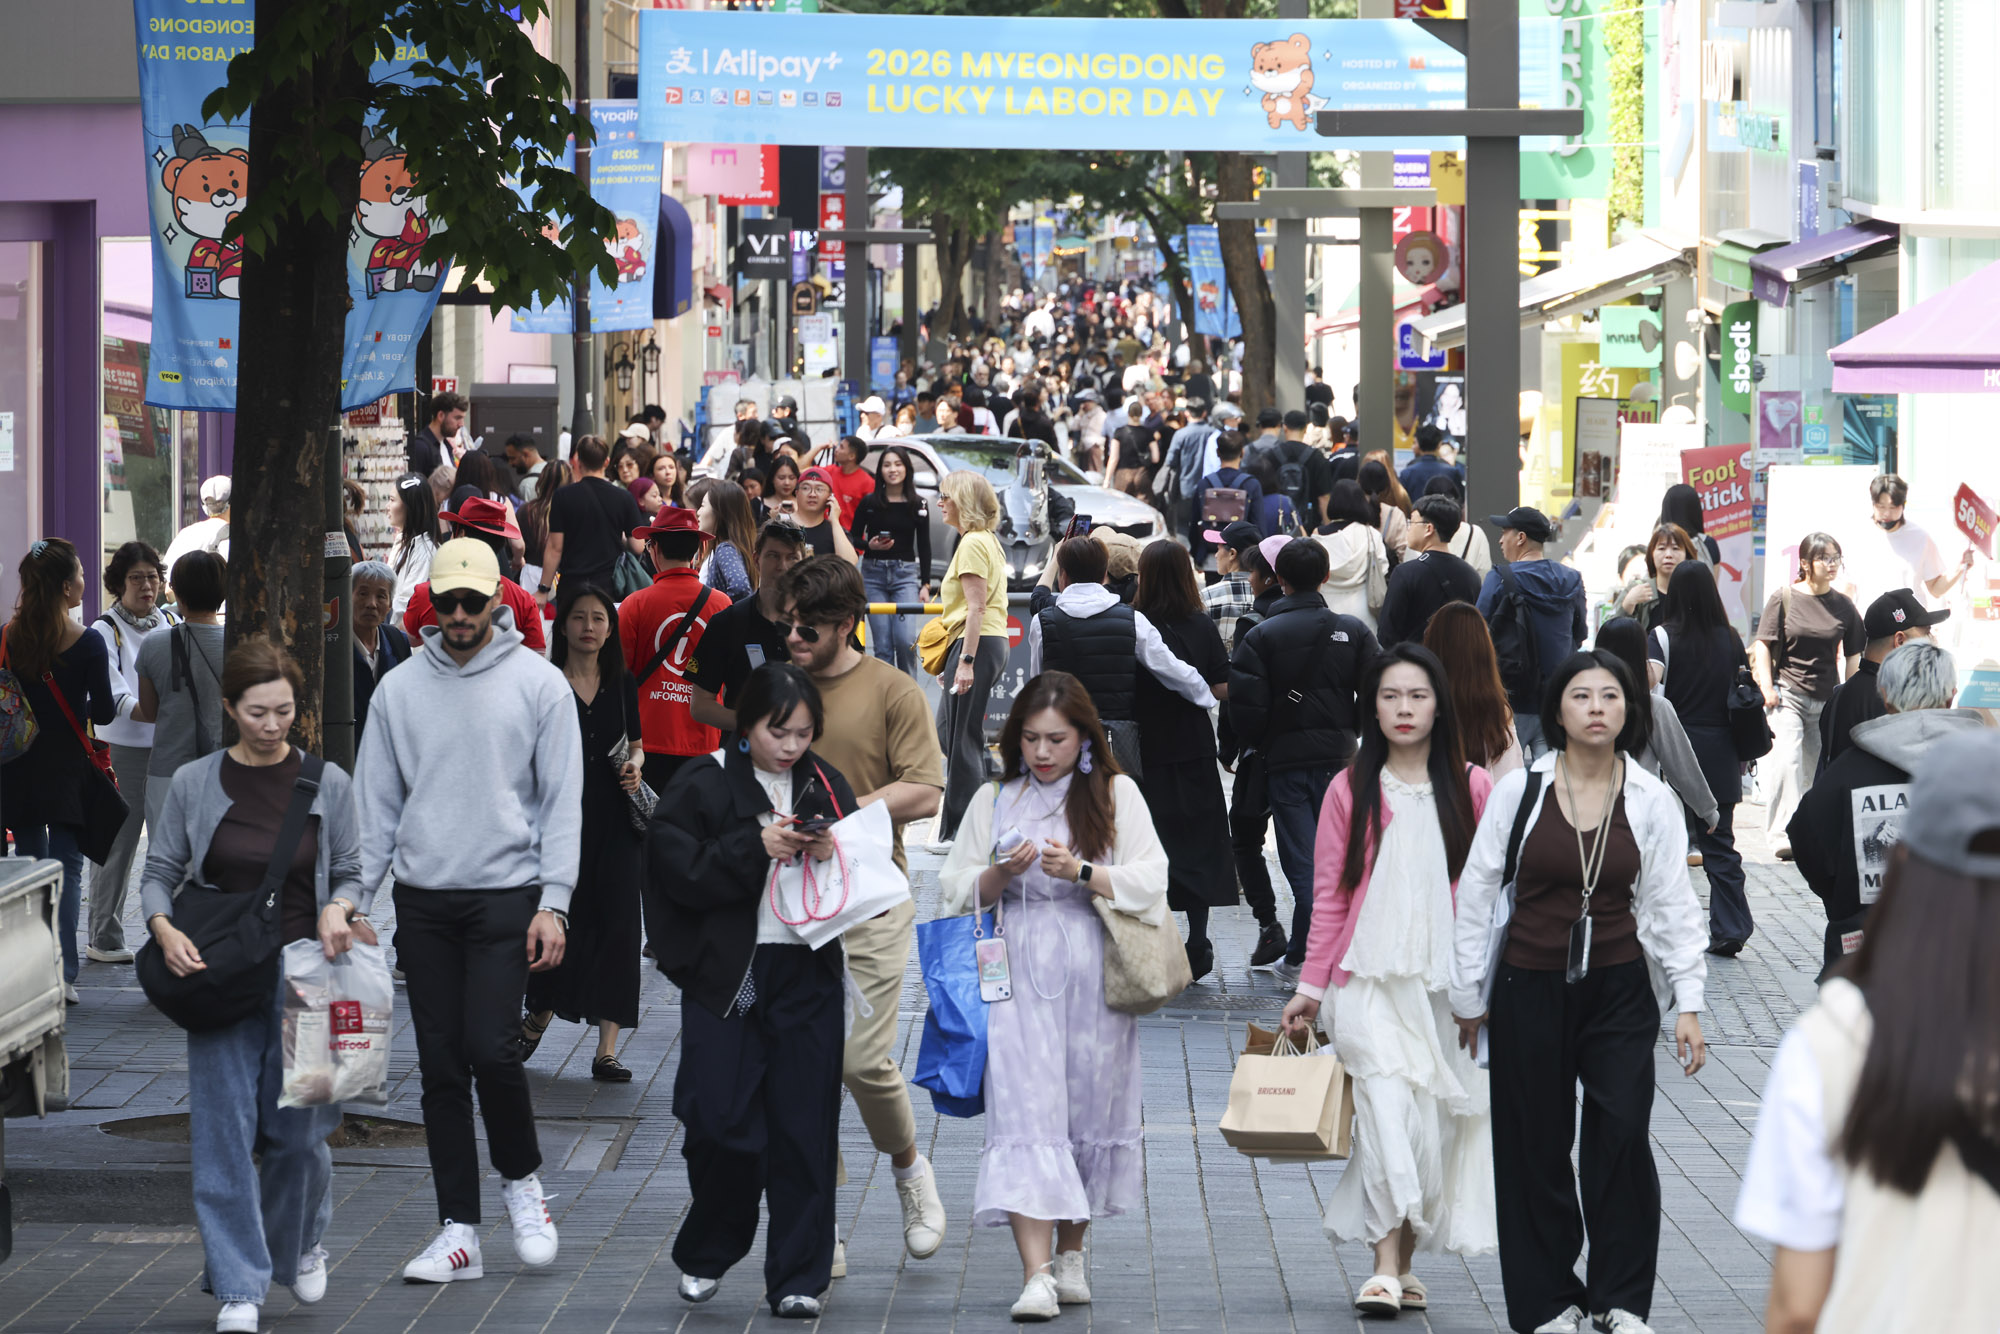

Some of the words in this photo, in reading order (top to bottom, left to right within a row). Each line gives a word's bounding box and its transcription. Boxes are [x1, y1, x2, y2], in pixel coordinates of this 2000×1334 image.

[714, 48, 842, 83] Alipay+
[867, 49, 951, 76] 2026
[961, 52, 1225, 80] MYEONGDONG
[867, 84, 996, 114] LUCKY
[1005, 86, 1132, 116] LABOR
[1143, 88, 1225, 116] DAY
[747, 234, 786, 255] VT
[1730, 321, 1751, 394] sbedt
[1688, 458, 1737, 488] Foot
[1957, 497, 1976, 530] 50
[661, 681, 693, 694] TOURIS
[1257, 1087, 1296, 1096] BRICKSAND
